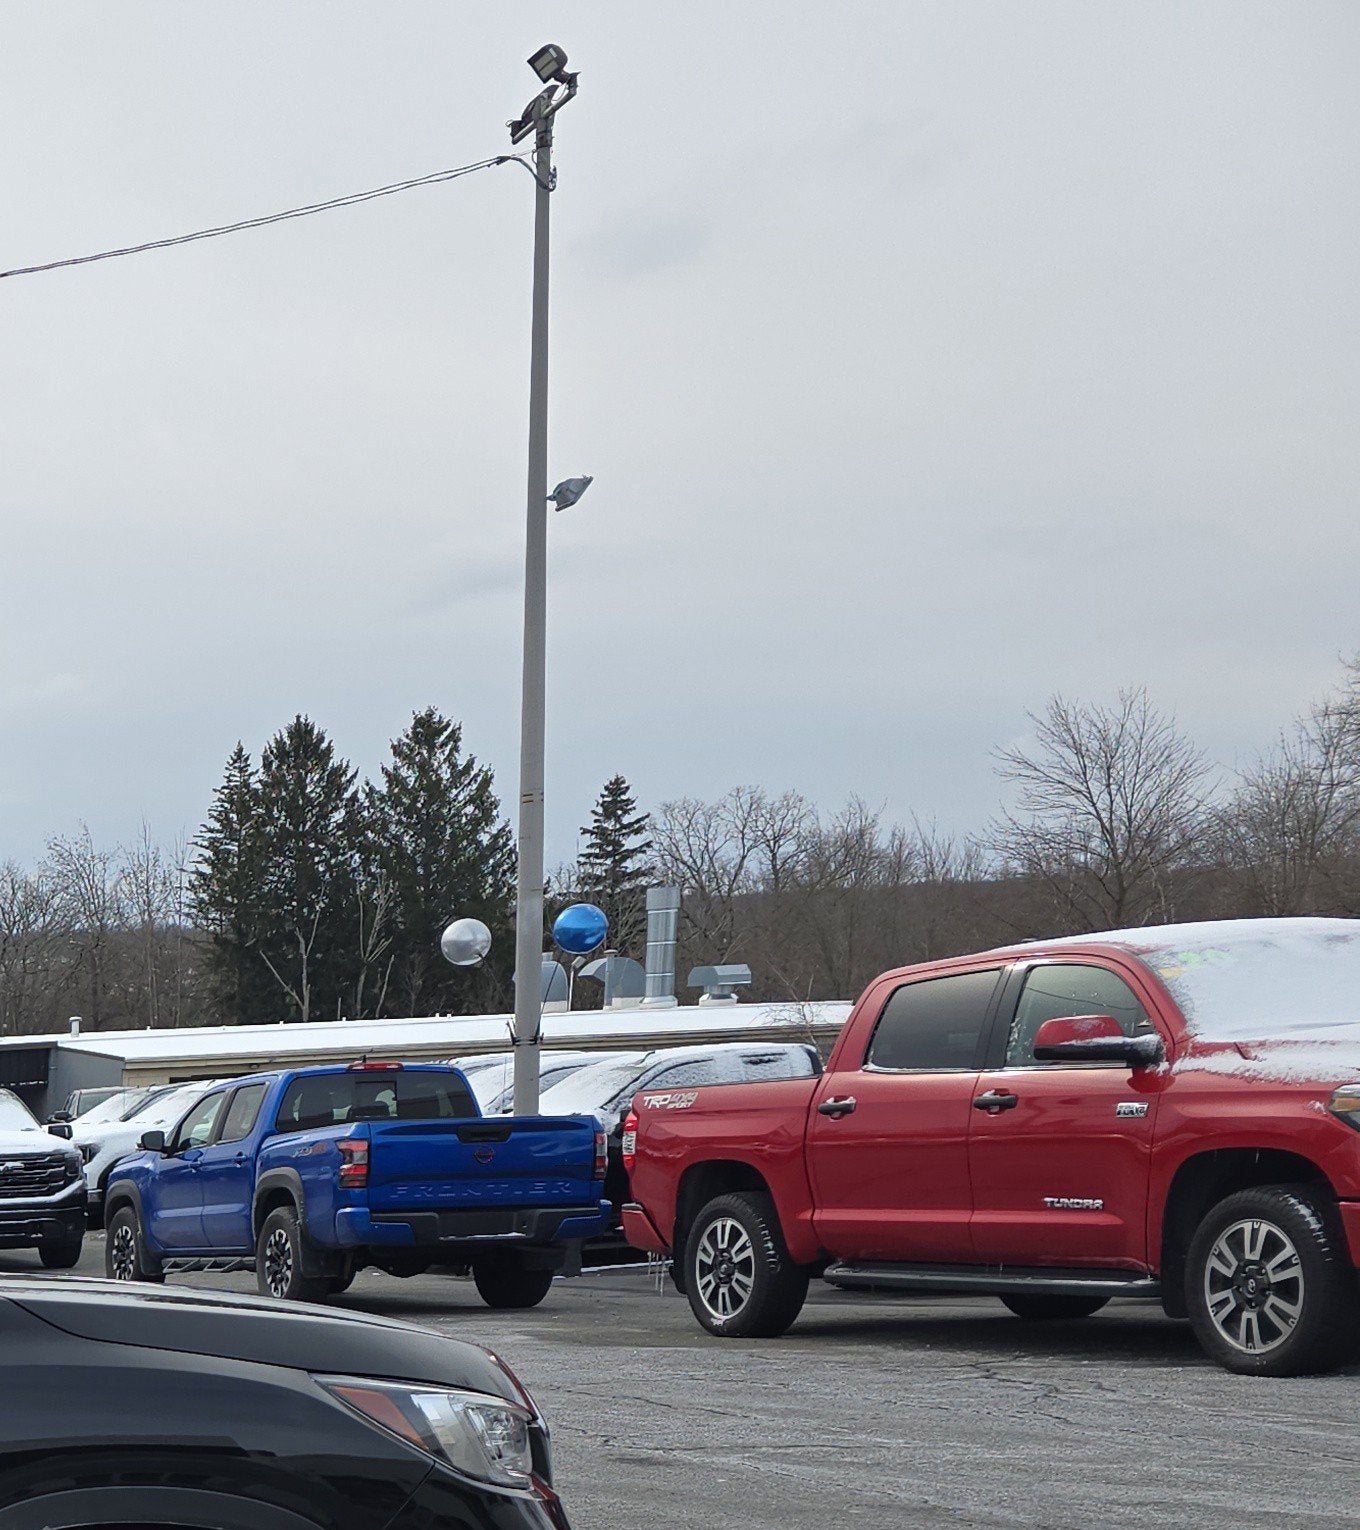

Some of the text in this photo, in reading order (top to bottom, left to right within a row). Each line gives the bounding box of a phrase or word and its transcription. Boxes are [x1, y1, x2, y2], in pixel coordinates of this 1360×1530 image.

[643, 1094, 672, 1110] TRD
[389, 1182, 572, 1199] FRONTIER
[1043, 1197, 1104, 1210] TUNDRA
